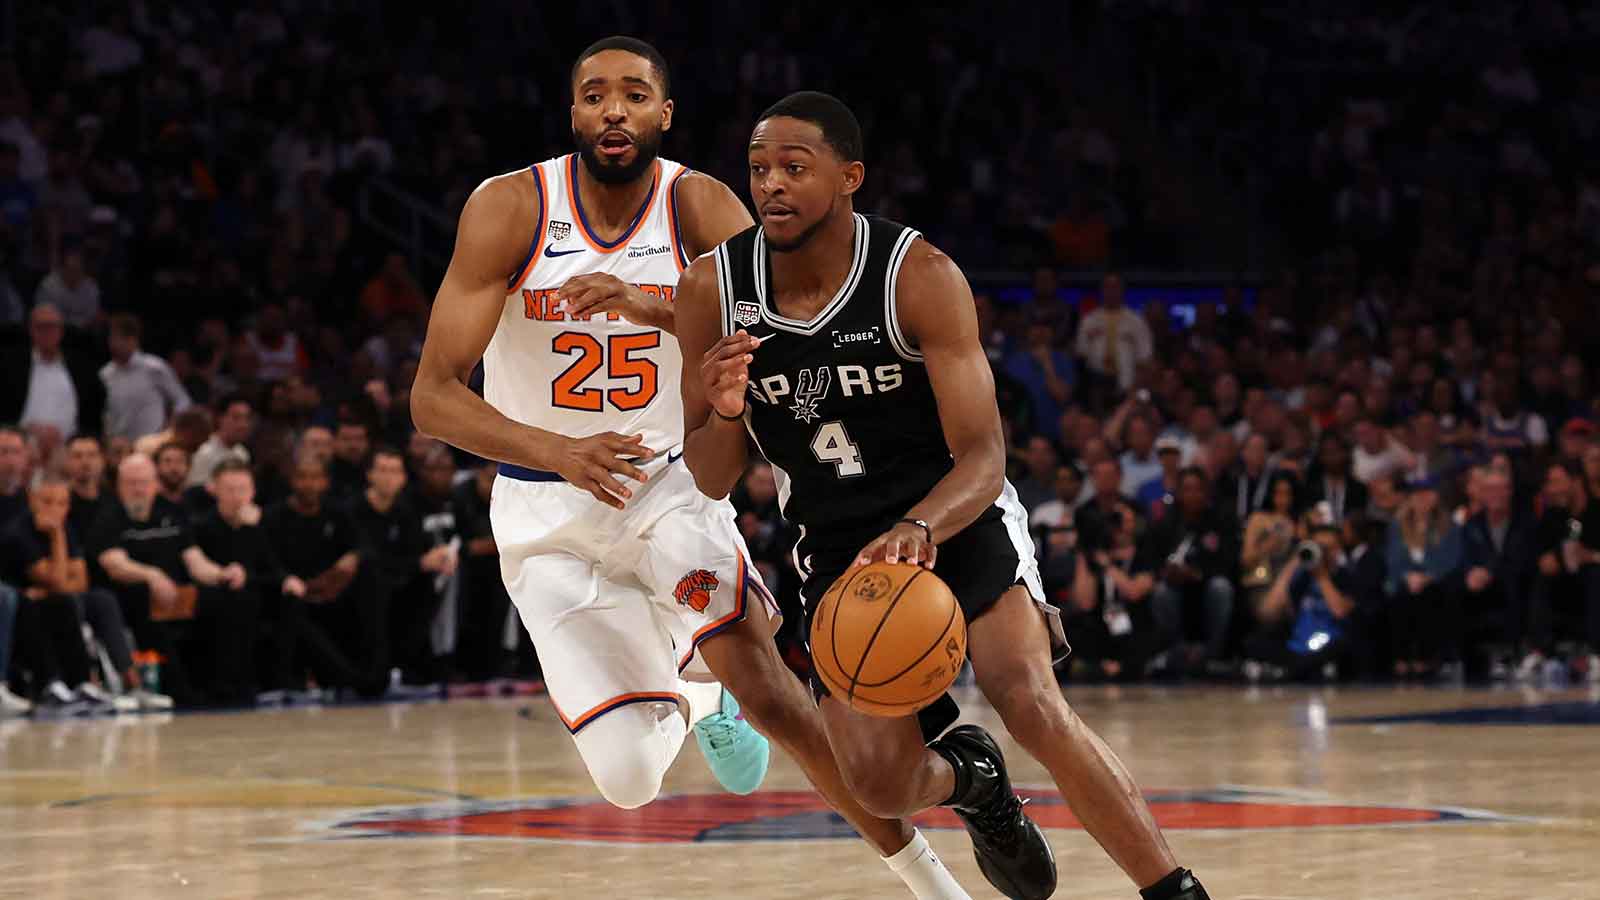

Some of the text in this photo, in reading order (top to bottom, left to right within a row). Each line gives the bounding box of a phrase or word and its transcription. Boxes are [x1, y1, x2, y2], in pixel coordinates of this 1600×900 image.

[550, 221, 570, 229] USA
[645, 244, 671, 255] dhabi
[738, 304, 758, 312] USA
[736, 313, 758, 321] 250
[838, 331, 874, 343] LEDGER
[552, 331, 661, 412] 25
[810, 420, 866, 479] 4
